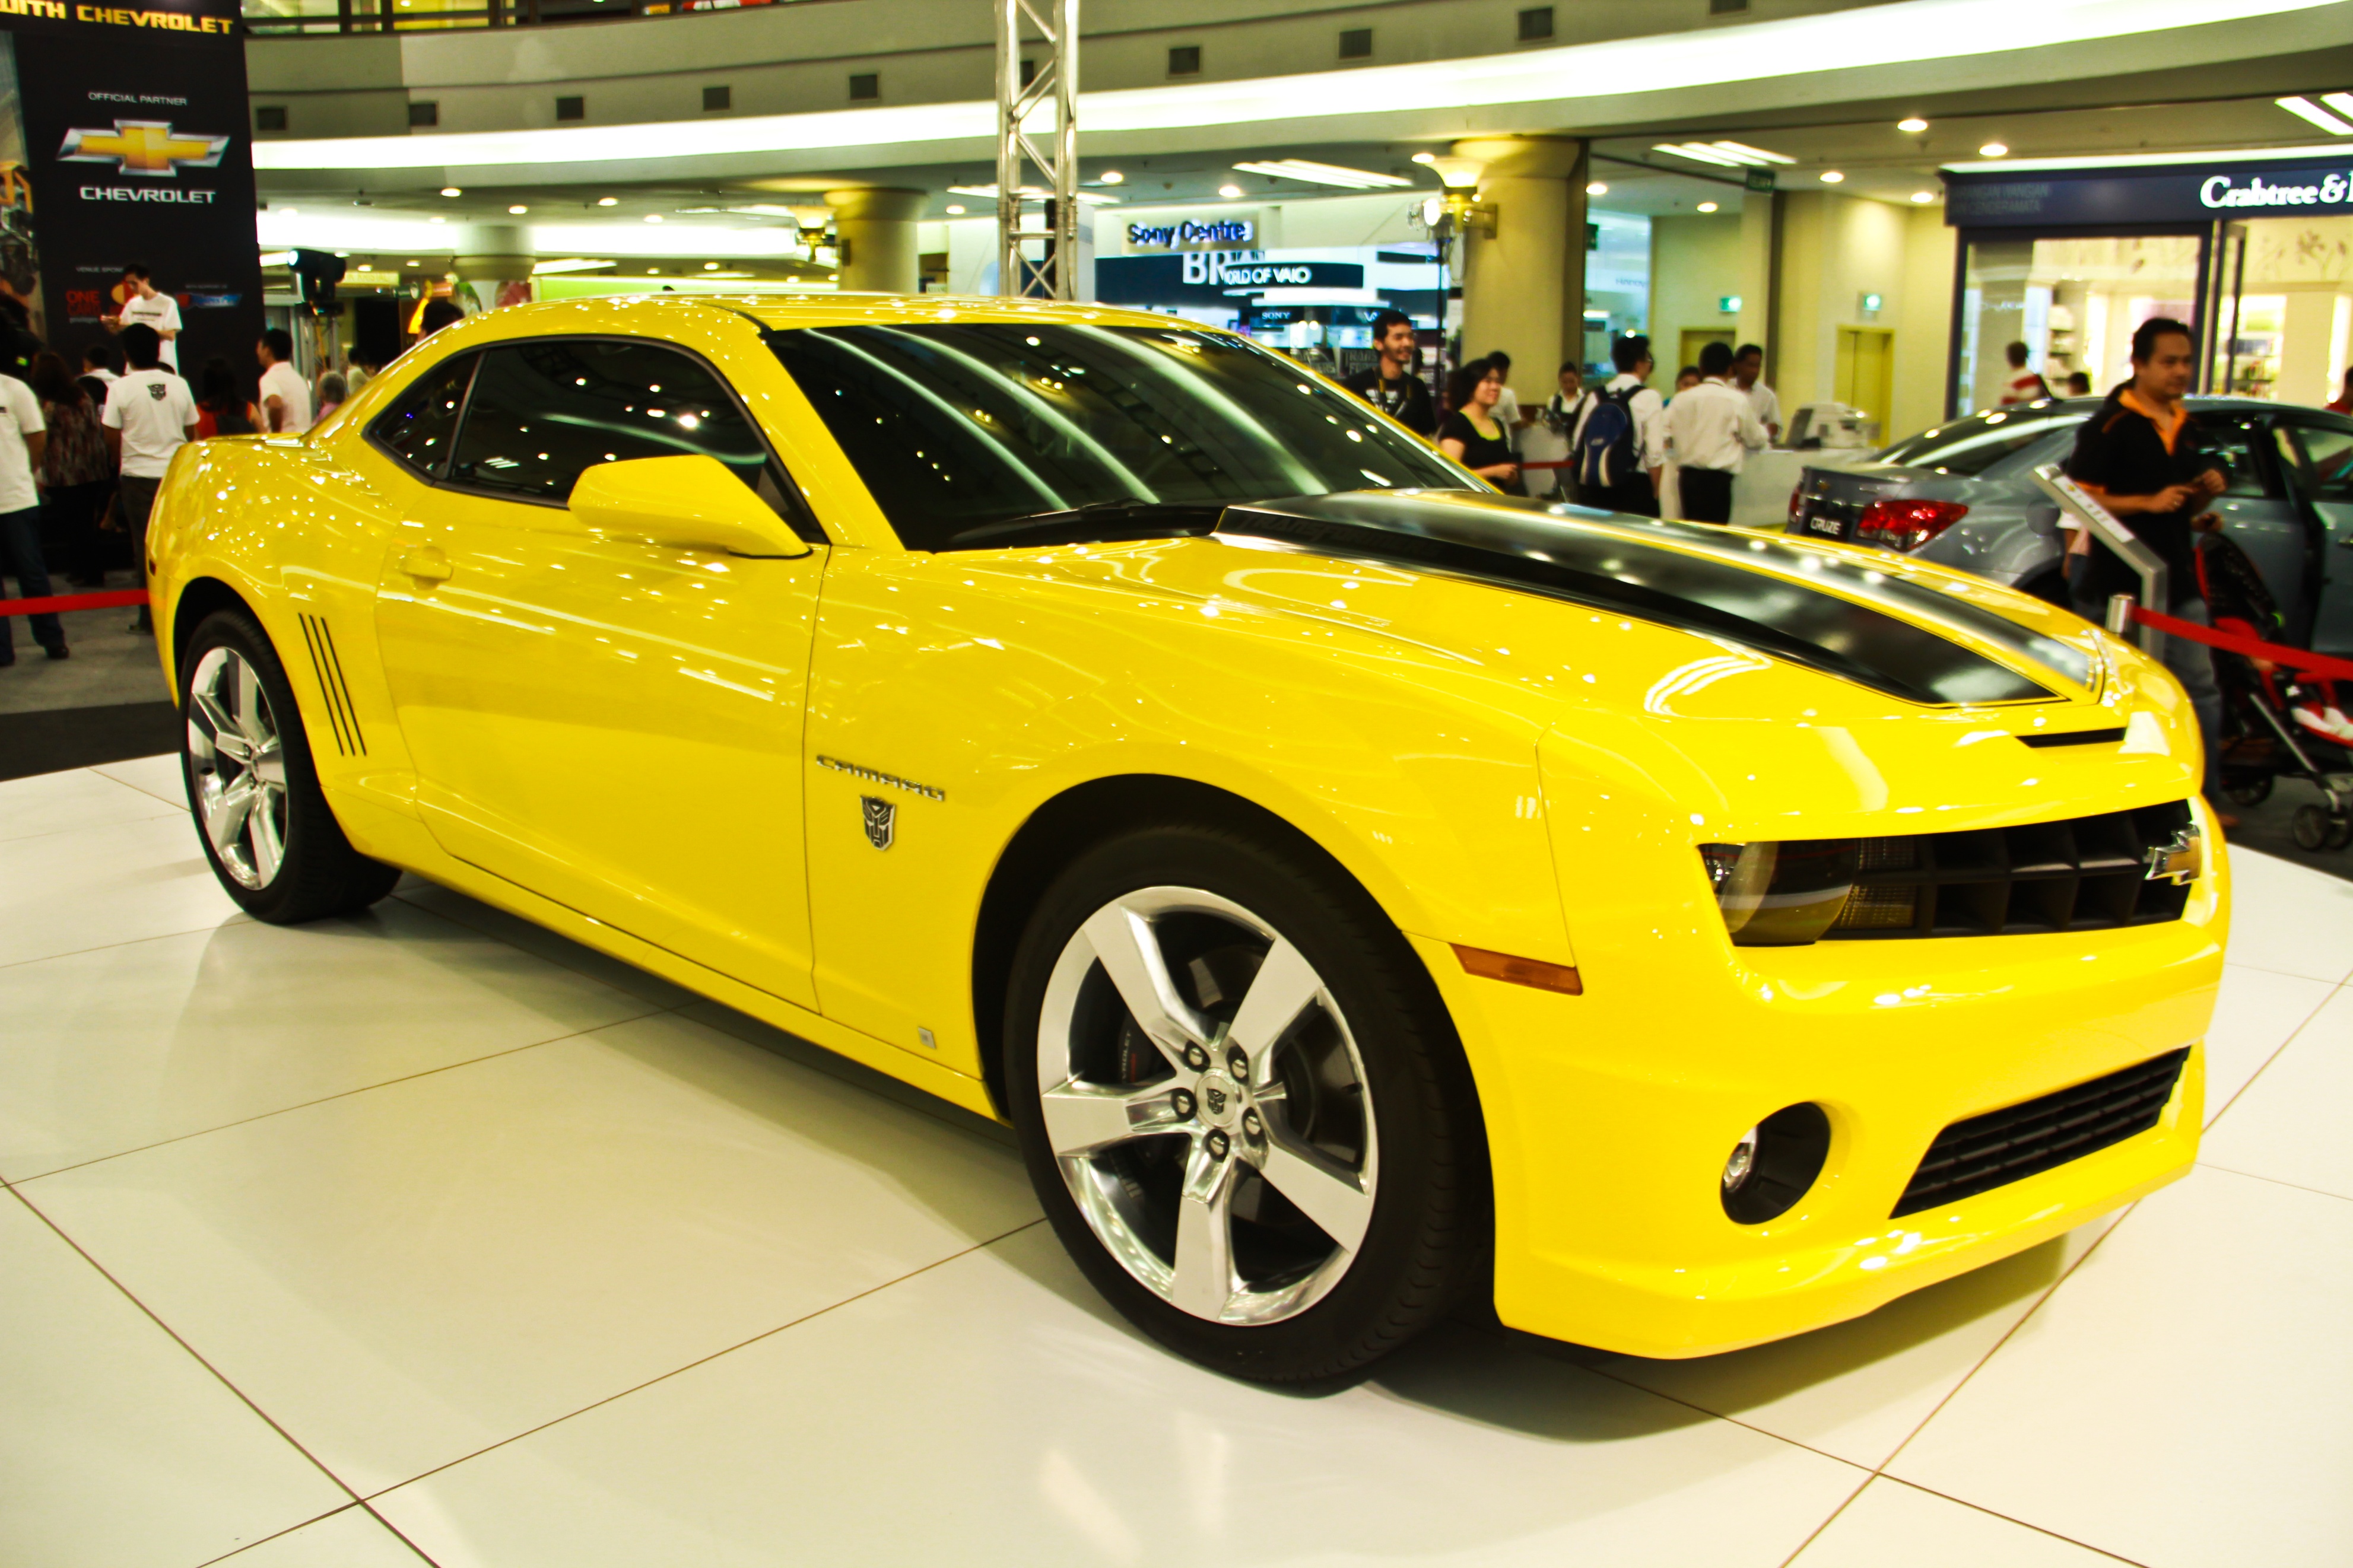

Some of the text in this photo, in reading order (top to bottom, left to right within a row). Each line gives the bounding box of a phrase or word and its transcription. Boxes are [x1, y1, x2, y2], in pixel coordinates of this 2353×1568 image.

[77, 5, 233, 34] CHEVROLET
[88, 92, 188, 106] OFFICIAL PARTNER
[80, 186, 216, 203] CHEVROLET
[2200, 176, 2319, 208] Crabtree
[1128, 221, 1180, 250] Sony
[1252, 267, 1272, 284] OF
[1272, 265, 1312, 284] VAIO
[66, 290, 100, 304] ONE
[1262, 311, 1290, 320] SONY
[1810, 517, 1843, 535] CRUZE
